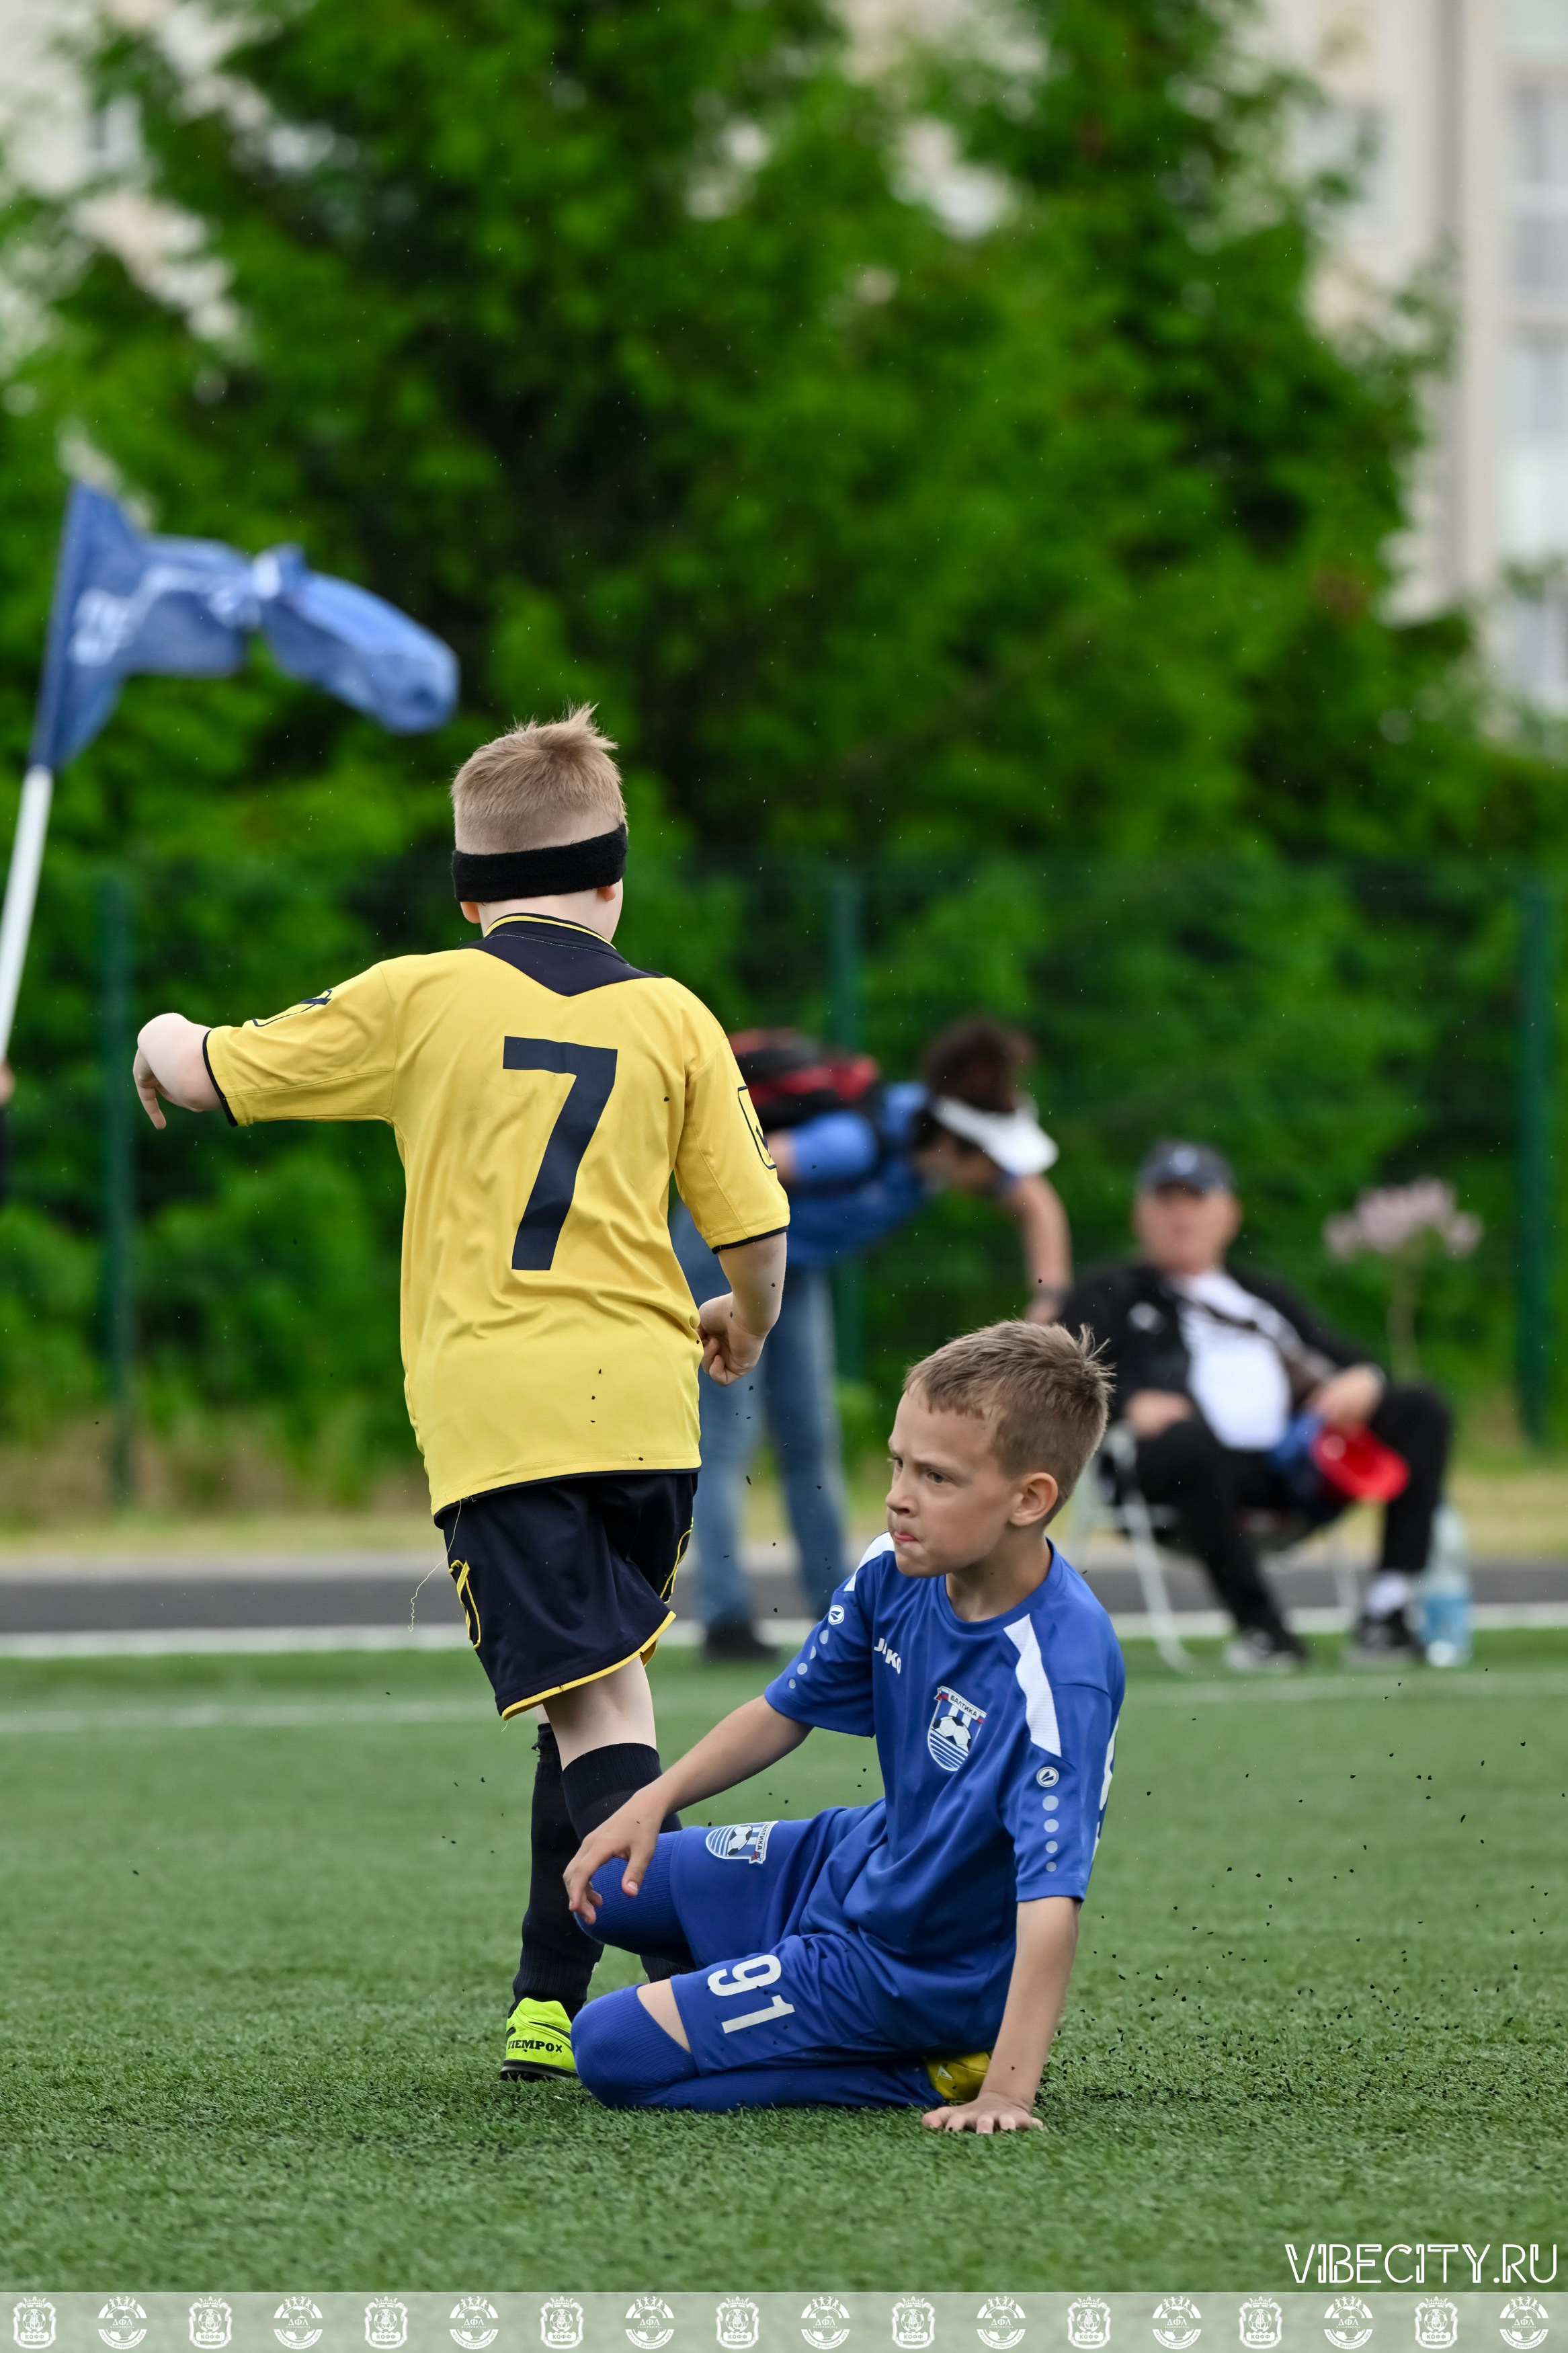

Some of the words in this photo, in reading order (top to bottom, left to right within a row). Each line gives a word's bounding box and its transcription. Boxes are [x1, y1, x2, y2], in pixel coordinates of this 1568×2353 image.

[503, 1035, 618, 1270] 7
[950, 1695, 978, 1717] БАЛТИКА
[708, 1954, 795, 2034] 91
